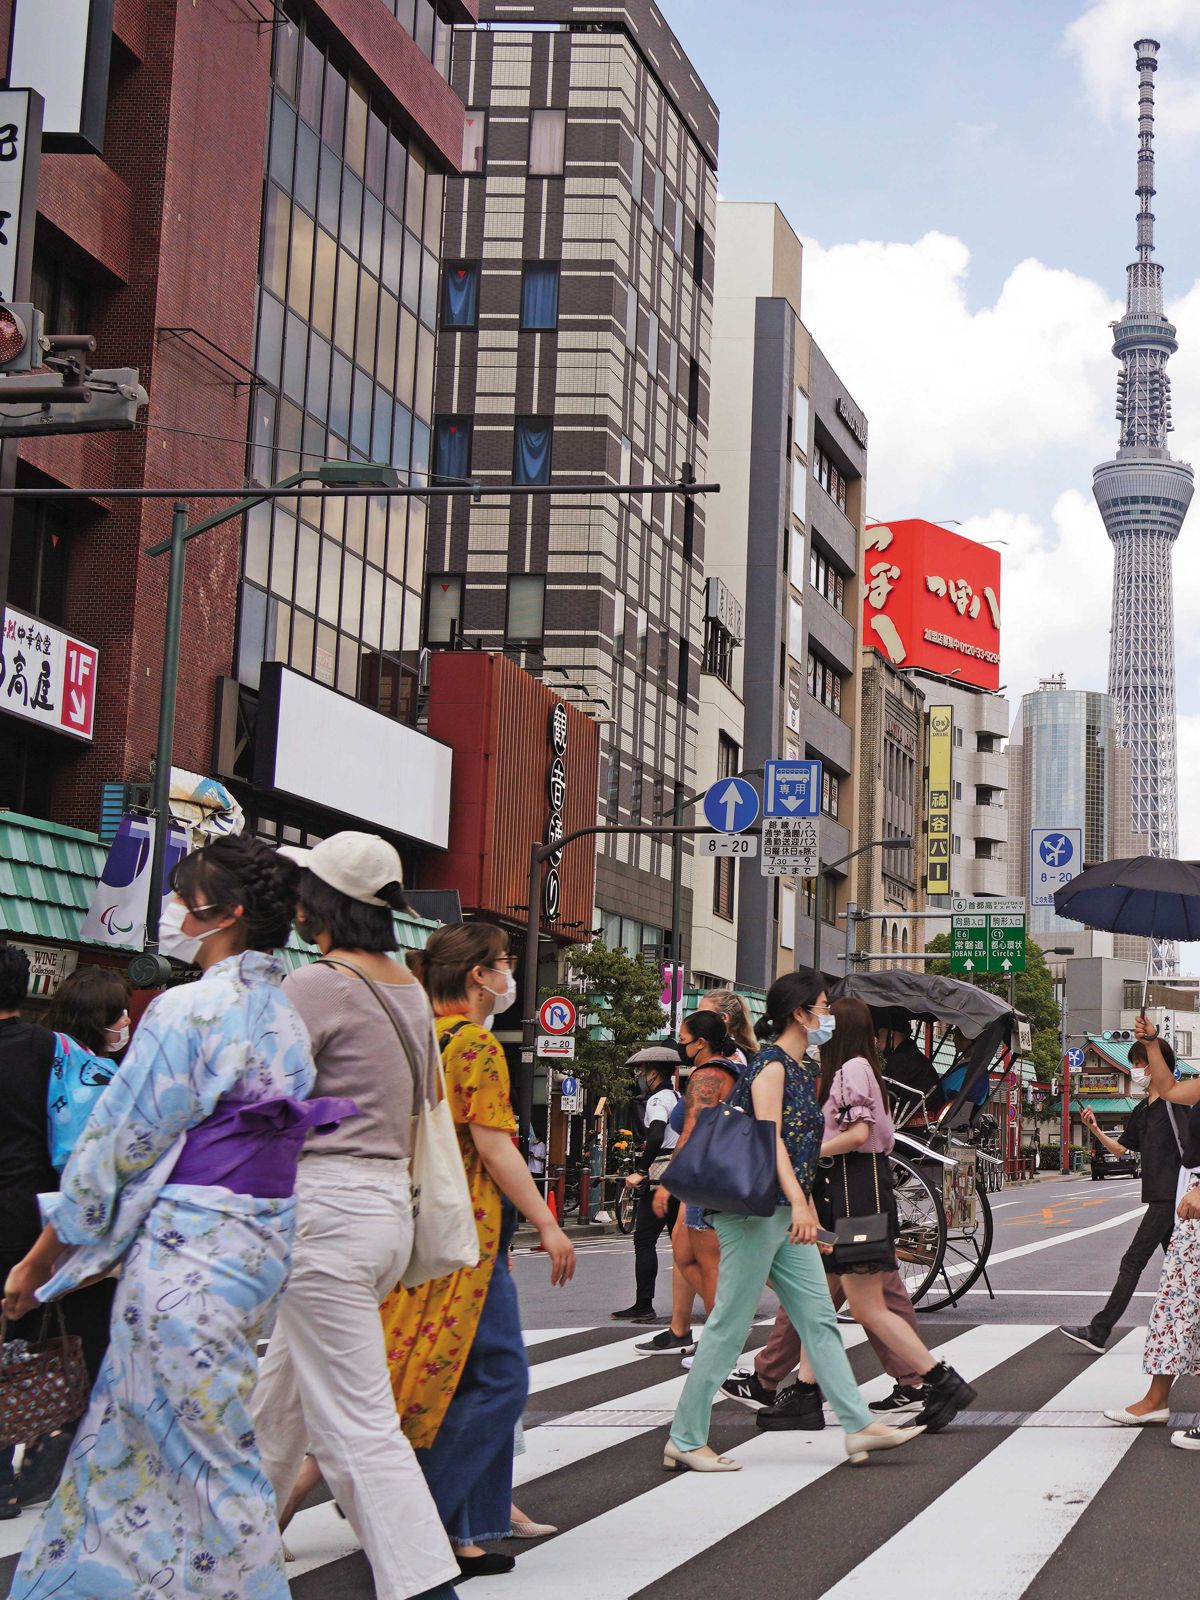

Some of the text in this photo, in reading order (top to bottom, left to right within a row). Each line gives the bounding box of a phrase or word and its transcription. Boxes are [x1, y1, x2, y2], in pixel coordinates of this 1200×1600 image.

[925, 575, 1001, 630] つぼ八
[69, 649, 92, 686] 1F
[0, 650, 55, 711] 高屋
[779, 784, 806, 795] 専用
[931, 793, 948, 880] 神谷バー
[767, 867, 811, 875] ここまで
[957, 901, 963, 910] 6
[968, 901, 993, 910] 首都高
[34, 950, 58, 967] WINE
[952, 950, 973, 958] JOBAN
[737, 1384, 753, 1397] N
